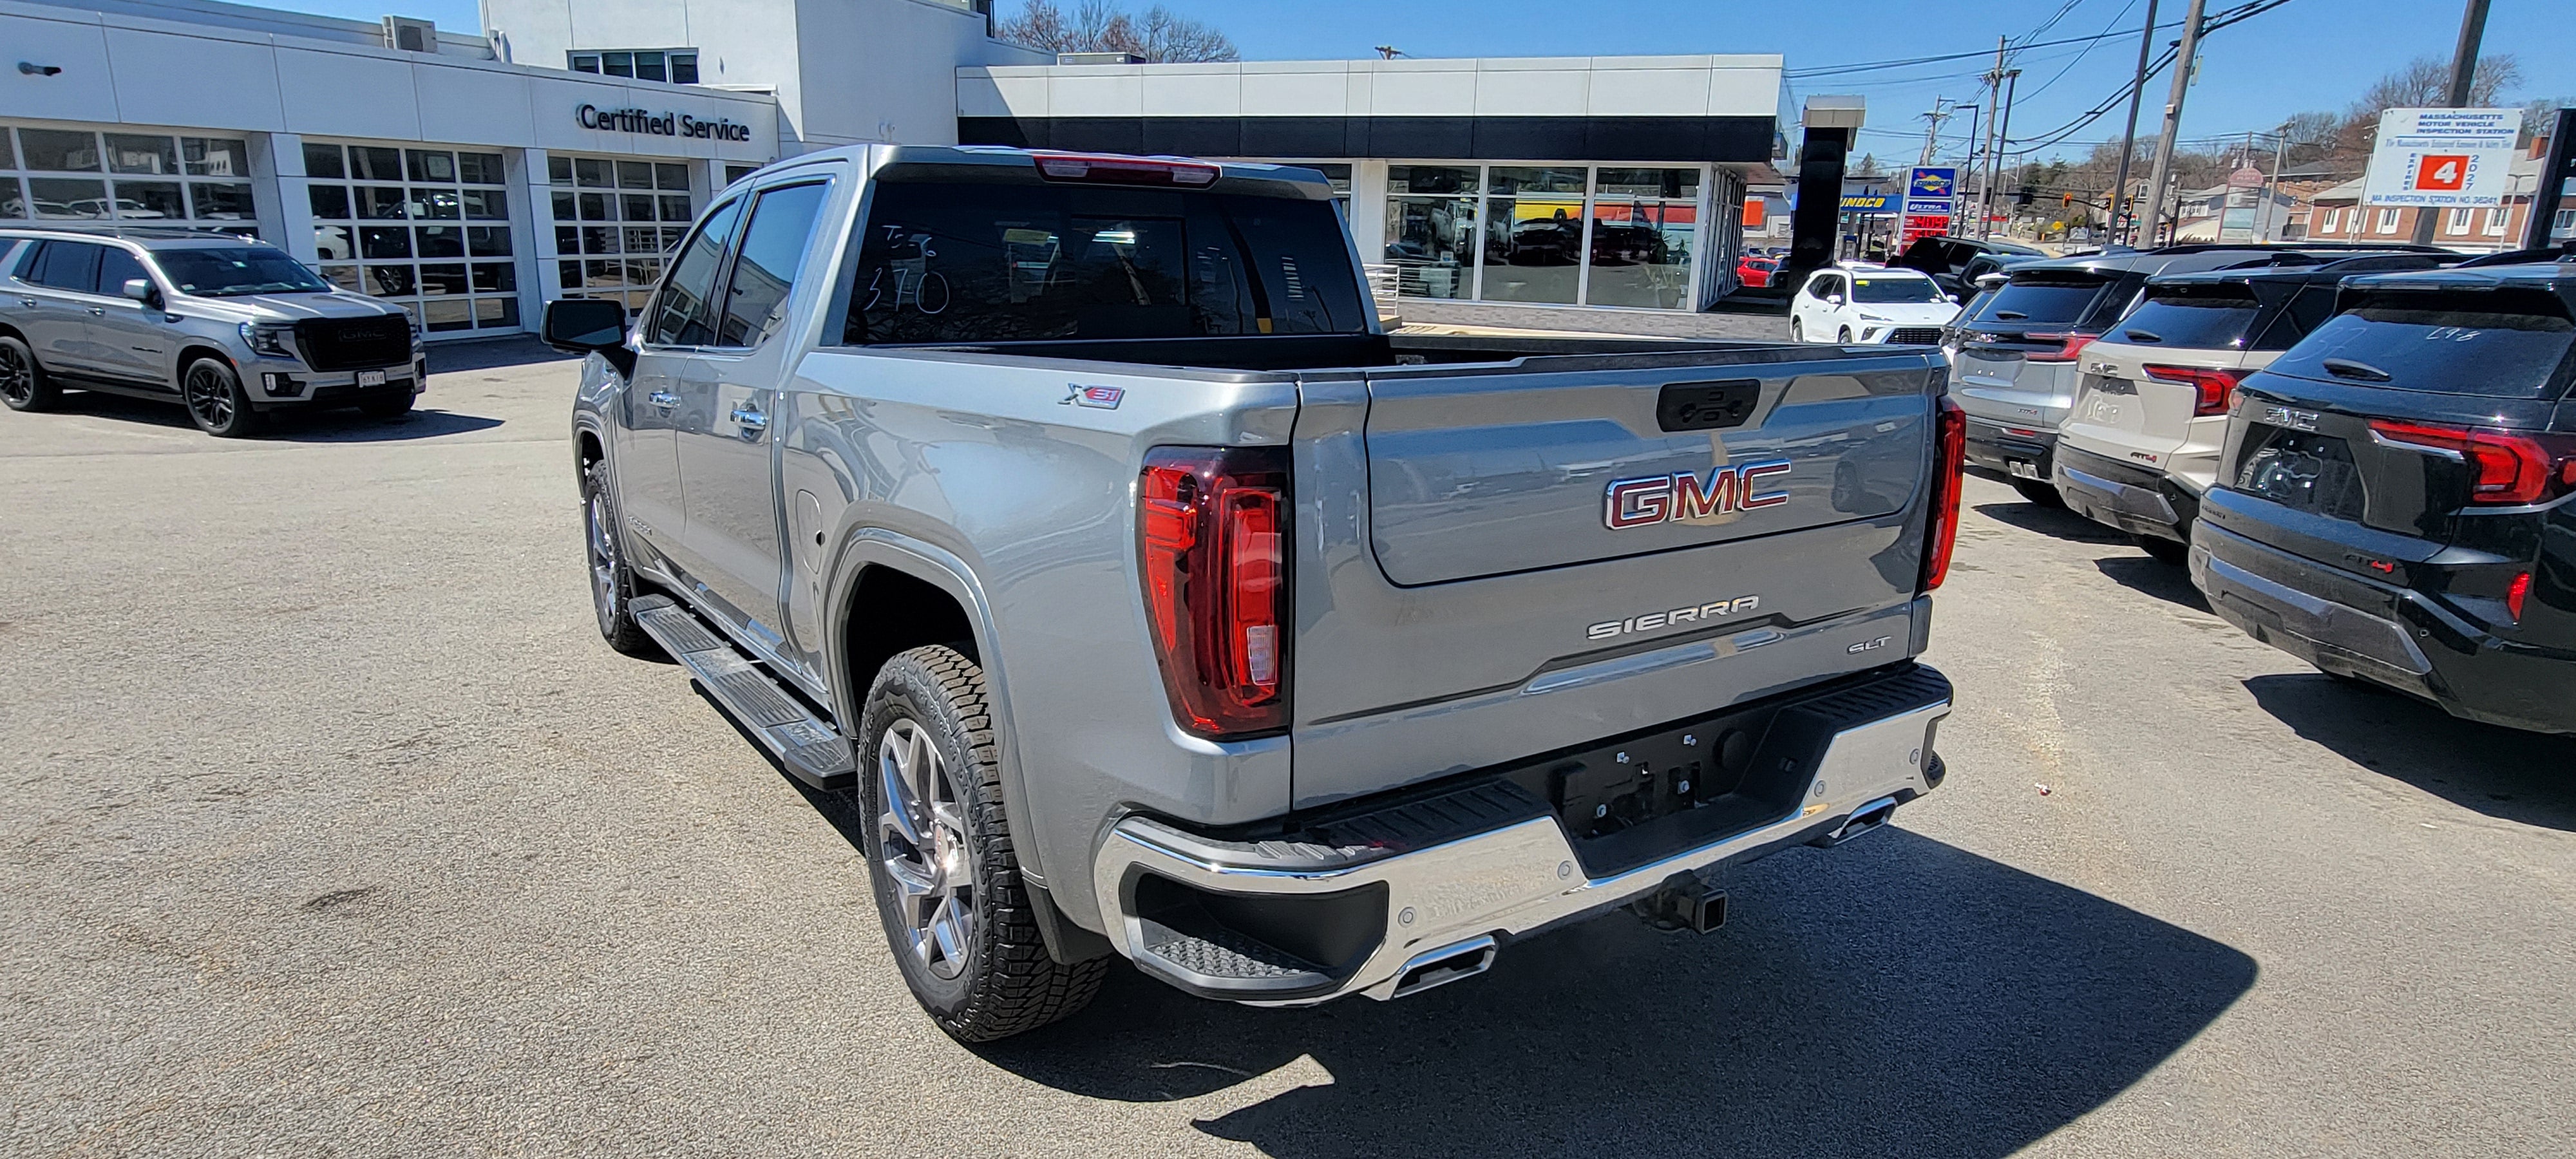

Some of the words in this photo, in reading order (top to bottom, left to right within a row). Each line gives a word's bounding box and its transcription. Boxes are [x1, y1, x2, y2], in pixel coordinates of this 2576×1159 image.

[579, 104, 676, 137] Certified
[681, 114, 750, 142] Service
[2433, 161, 2458, 184] 4
[1839, 197, 1886, 208] UNOCO
[2384, 194, 2426, 203] INSPECTION
[2429, 195, 2456, 204] STATION
[2265, 406, 2319, 432] GMC
[1605, 458, 1792, 531] GMC
[1586, 594, 1760, 640] SIERRA
[1847, 635, 1893, 655] SLT
